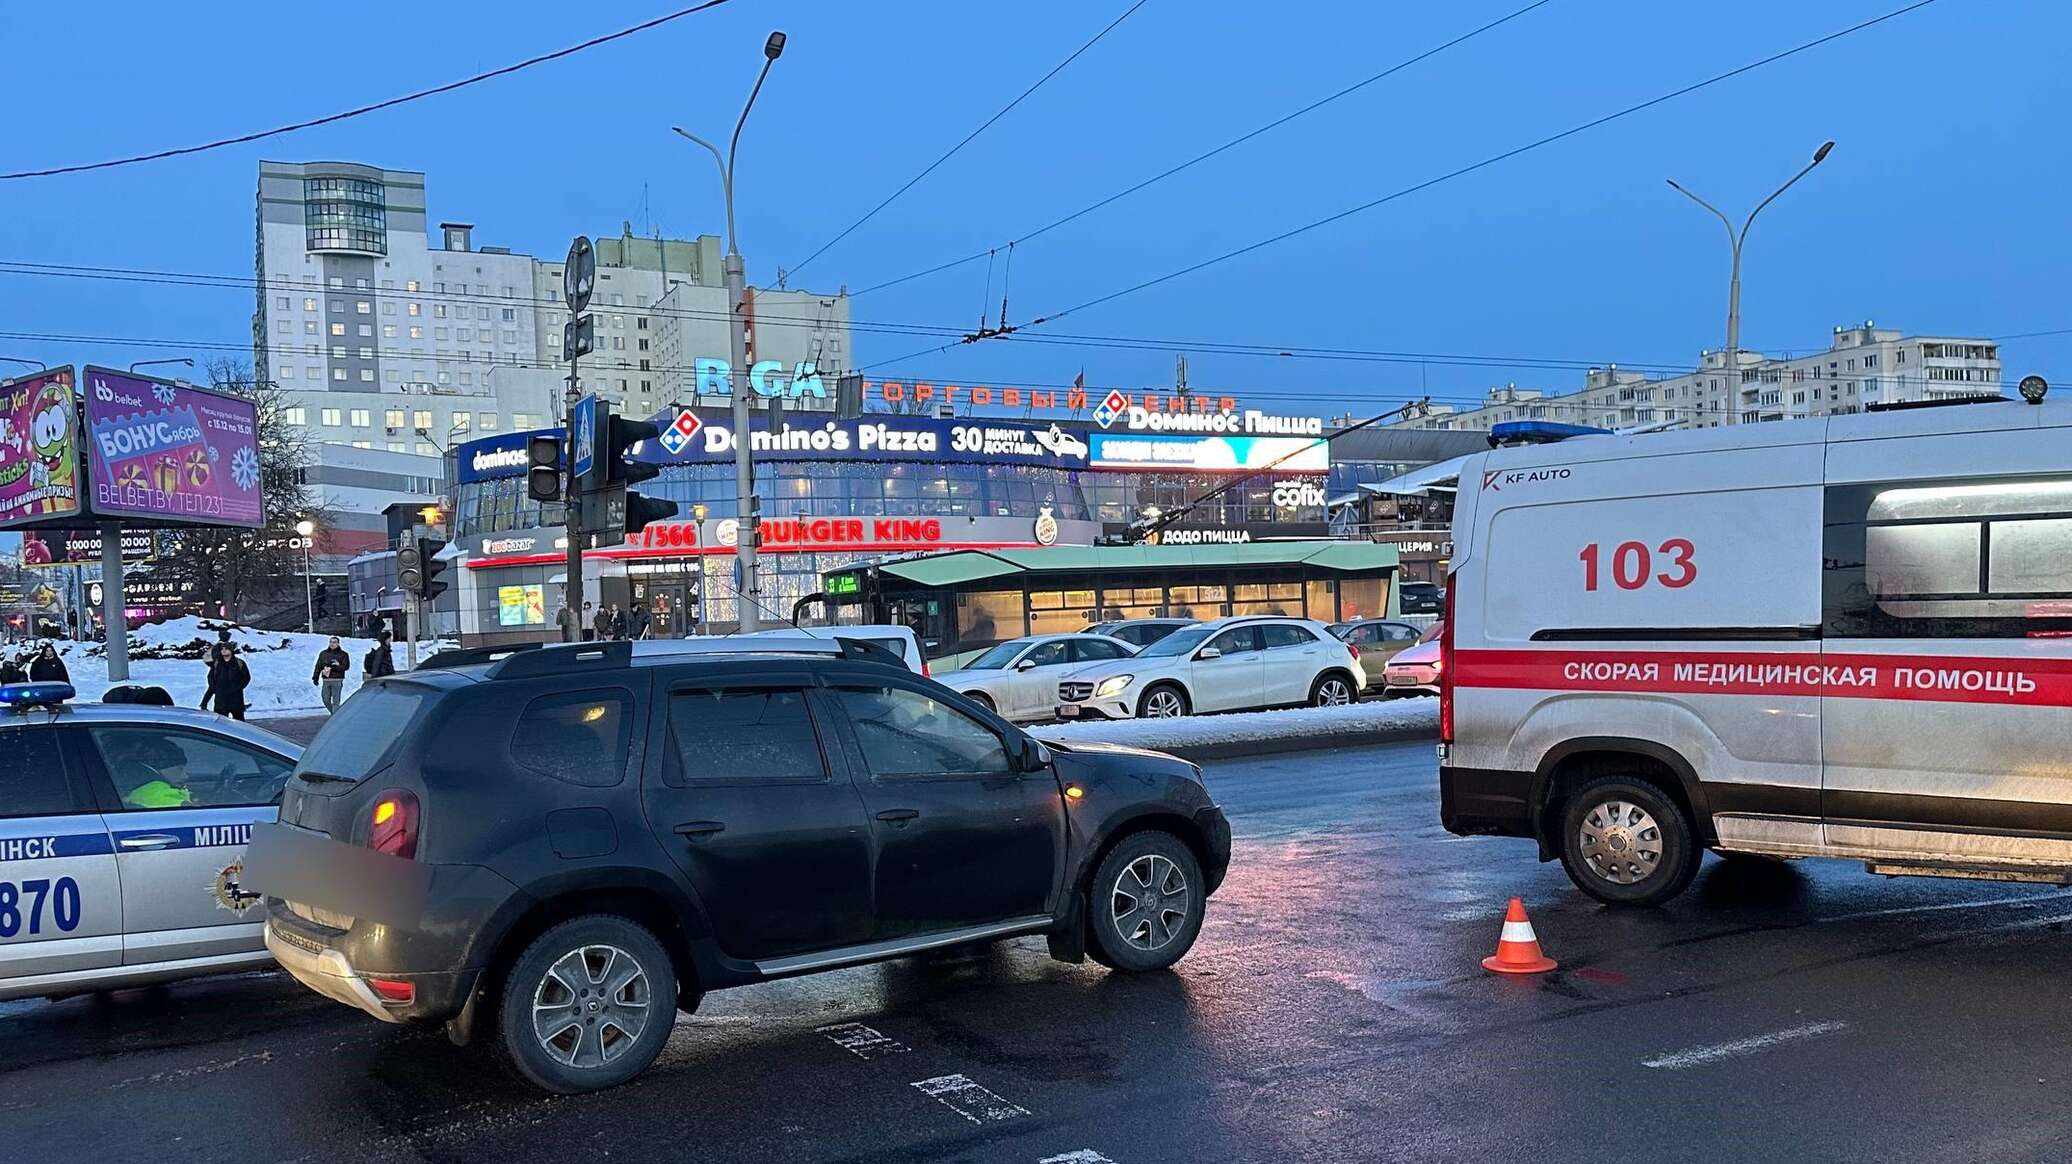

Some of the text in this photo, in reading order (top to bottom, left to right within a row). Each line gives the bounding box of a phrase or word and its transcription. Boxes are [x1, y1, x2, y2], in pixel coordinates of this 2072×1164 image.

[695, 357, 828, 399] RGA
[114, 393, 143, 408] belbet
[862, 381, 1088, 410] ТОРГОВЫЙ
[1244, 410, 1323, 435] Пицца
[98, 421, 201, 459] БОНУСябрь
[858, 423, 937, 452] Pizza
[951, 426, 1026, 452] 30 МИНУТ
[982, 440, 1044, 457] ДОСТАВКА
[473, 447, 529, 471] dominos.
[1505, 468, 1571, 484] KF AUTO
[1273, 483, 1326, 506] cofix
[90, 538, 102, 549] 00
[759, 518, 865, 544] BURGER
[873, 518, 942, 542] KING
[1162, 529, 1250, 546] ДОДО ПИЦЦА
[1398, 541, 1433, 554] ЦЕРИЯ
[1580, 538, 1697, 592] 103
[1563, 661, 2037, 696] СКОРАЯ МЕДИЦИНСКАЯ ПОМОЩЬ
[0, 825, 252, 861] ІНСК МІЛІЦ
